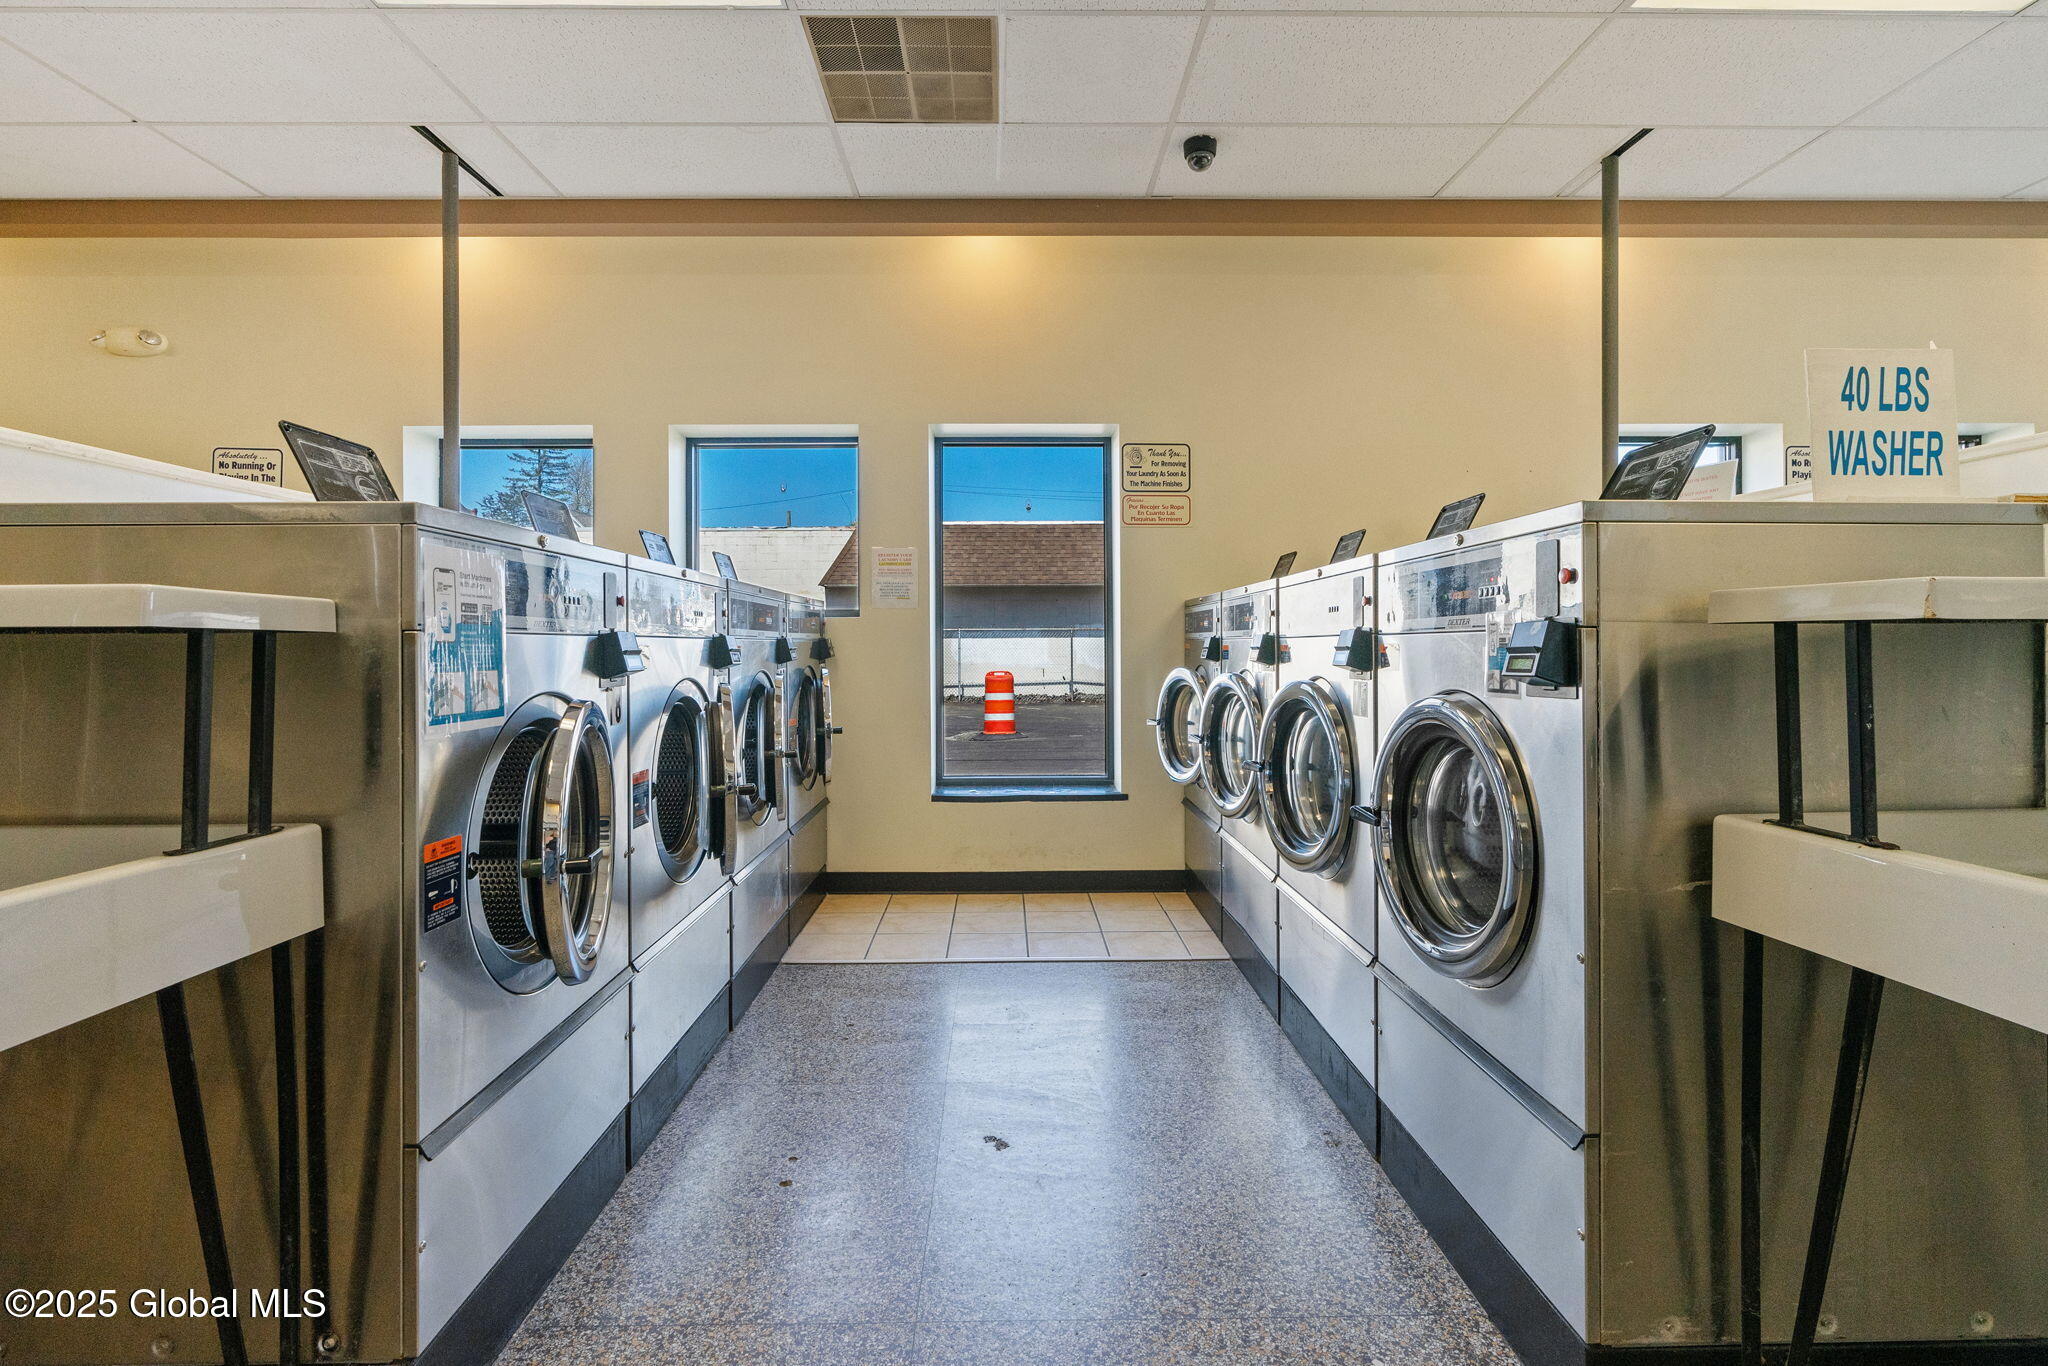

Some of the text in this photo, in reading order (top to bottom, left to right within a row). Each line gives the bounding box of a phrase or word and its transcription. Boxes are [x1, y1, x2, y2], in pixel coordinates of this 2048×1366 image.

[1841, 367, 1929, 412] 40 LBS
[1148, 448, 1166, 456] Thank
[1828, 430, 1943, 476] WASHER
[219, 461, 276, 471] No Running Or
[261, 474, 275, 482] The
[1792, 470, 1811, 480] Playi
